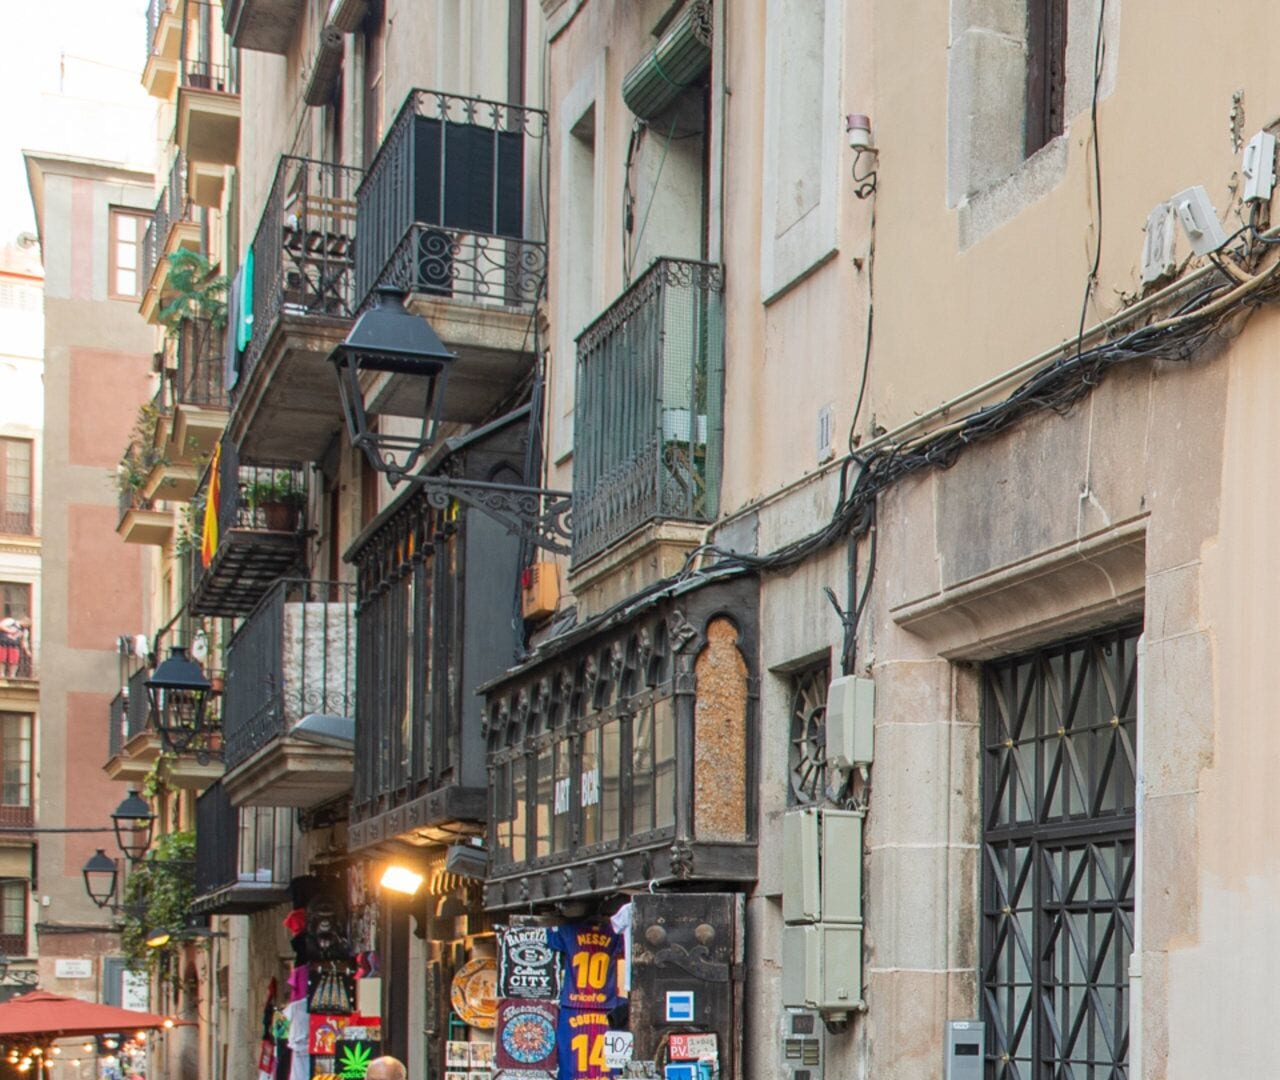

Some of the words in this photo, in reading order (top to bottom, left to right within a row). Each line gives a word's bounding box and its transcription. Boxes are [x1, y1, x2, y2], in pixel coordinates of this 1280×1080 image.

[577, 933, 612, 947] MESSI
[572, 951, 610, 990] 10
[510, 975, 550, 987] CITY
[569, 993, 595, 1002] unicef
[571, 1034, 611, 1072] 14
